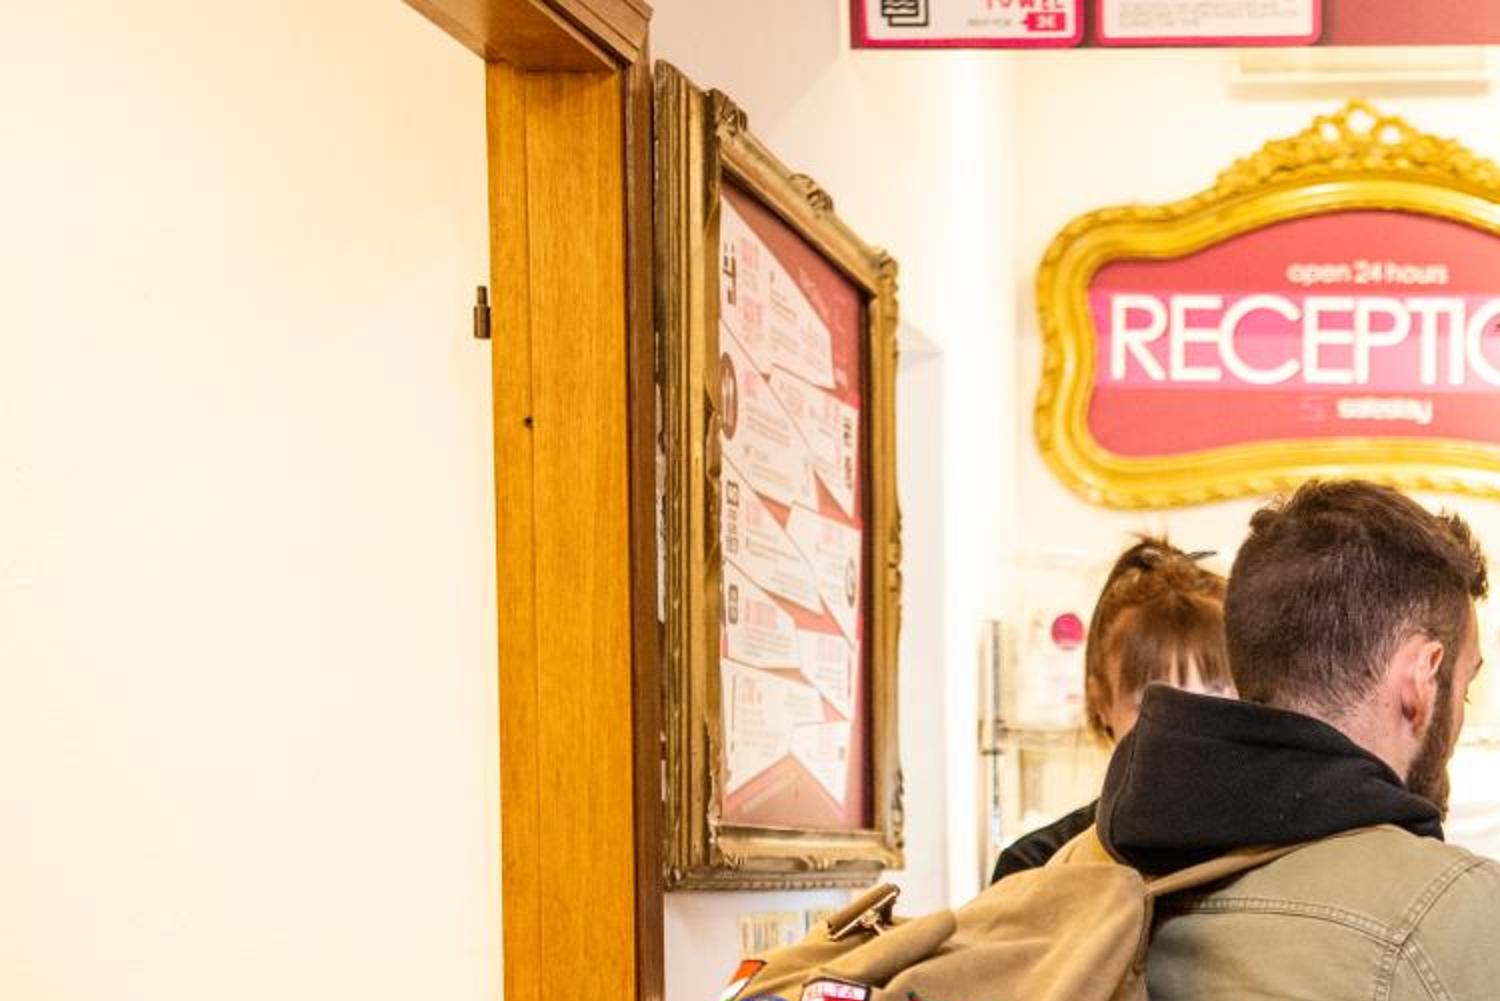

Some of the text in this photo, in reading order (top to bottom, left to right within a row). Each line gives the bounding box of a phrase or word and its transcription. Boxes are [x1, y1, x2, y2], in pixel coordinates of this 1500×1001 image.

[1286, 259, 1449, 287] open 24 hours
